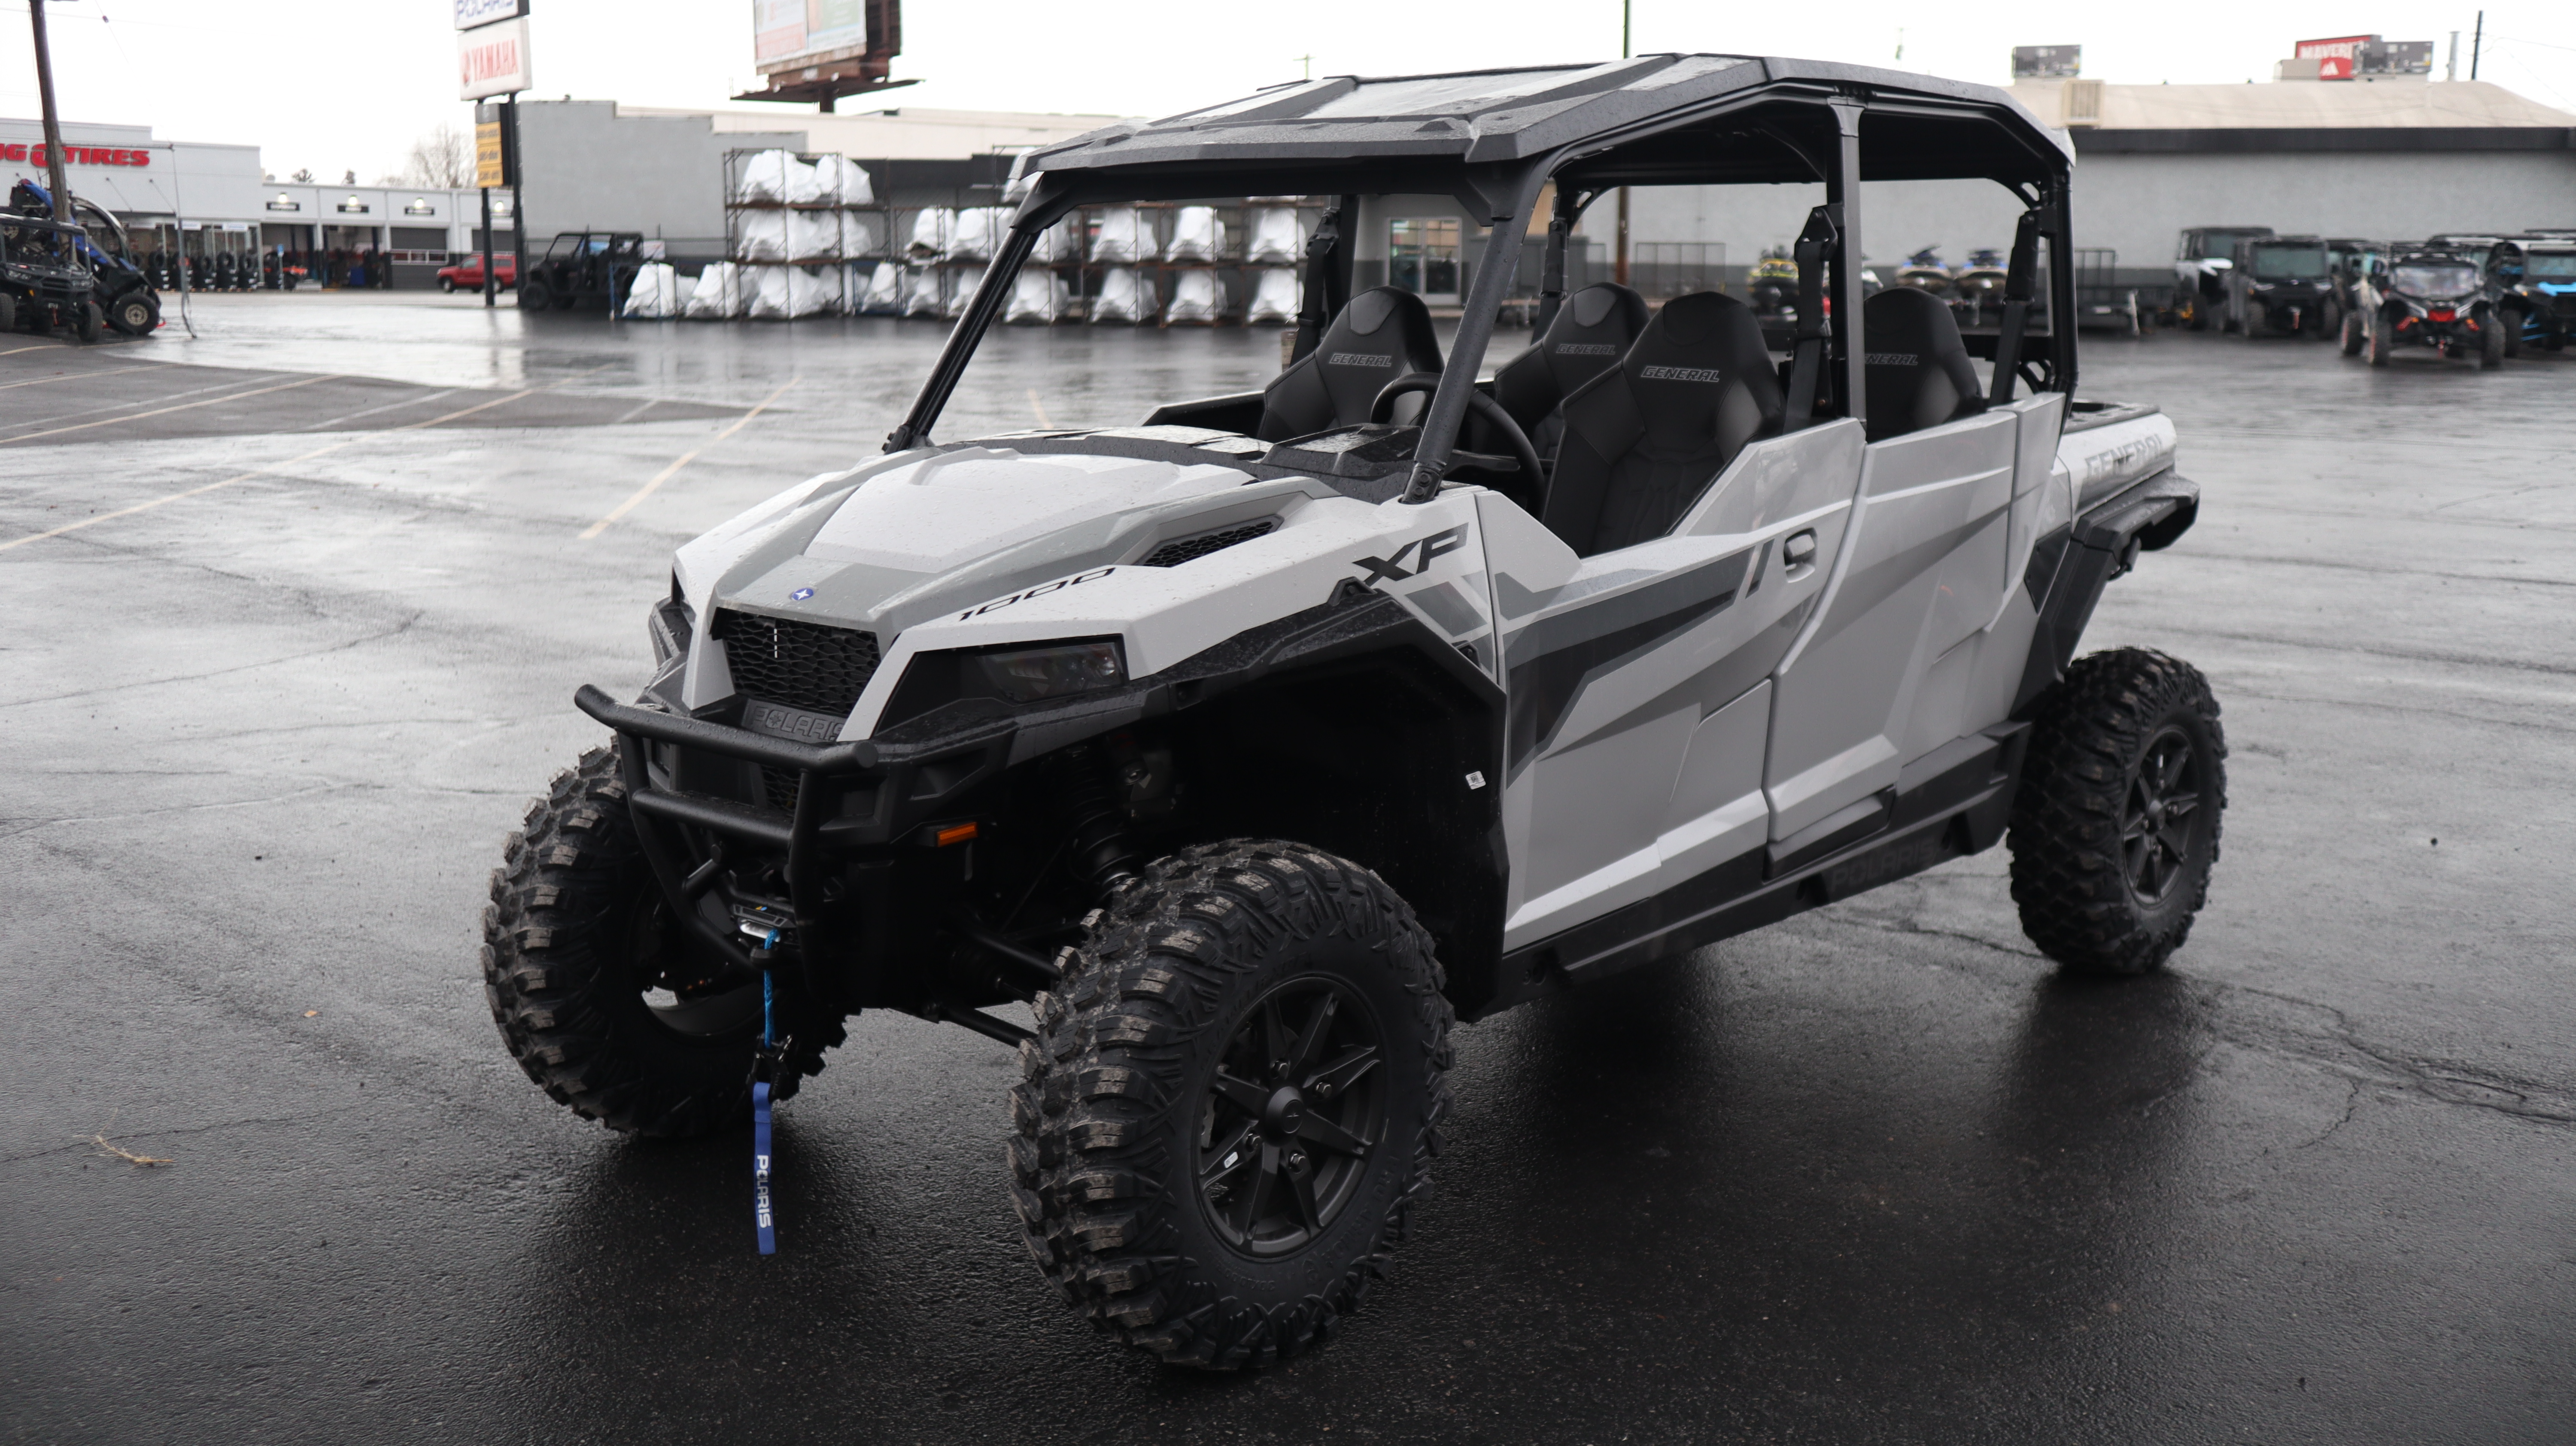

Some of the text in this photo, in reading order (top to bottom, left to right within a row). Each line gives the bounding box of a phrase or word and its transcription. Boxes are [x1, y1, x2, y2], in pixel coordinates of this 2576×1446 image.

[471, 39, 519, 82] YAMAHA
[2300, 43, 2353, 60] MAVER
[62, 146, 150, 166] TIRES
[1556, 344, 1616, 355] GENERAL
[1864, 354, 1918, 365] NERAL
[1329, 353, 1392, 367] GENERAL
[1640, 366, 1719, 382] GENERAL
[1352, 522, 1469, 587] XP
[959, 567, 1116, 621] 1000
[1831, 838, 1937, 892] POLARIS
[757, 1155, 772, 1228] POLARIS
